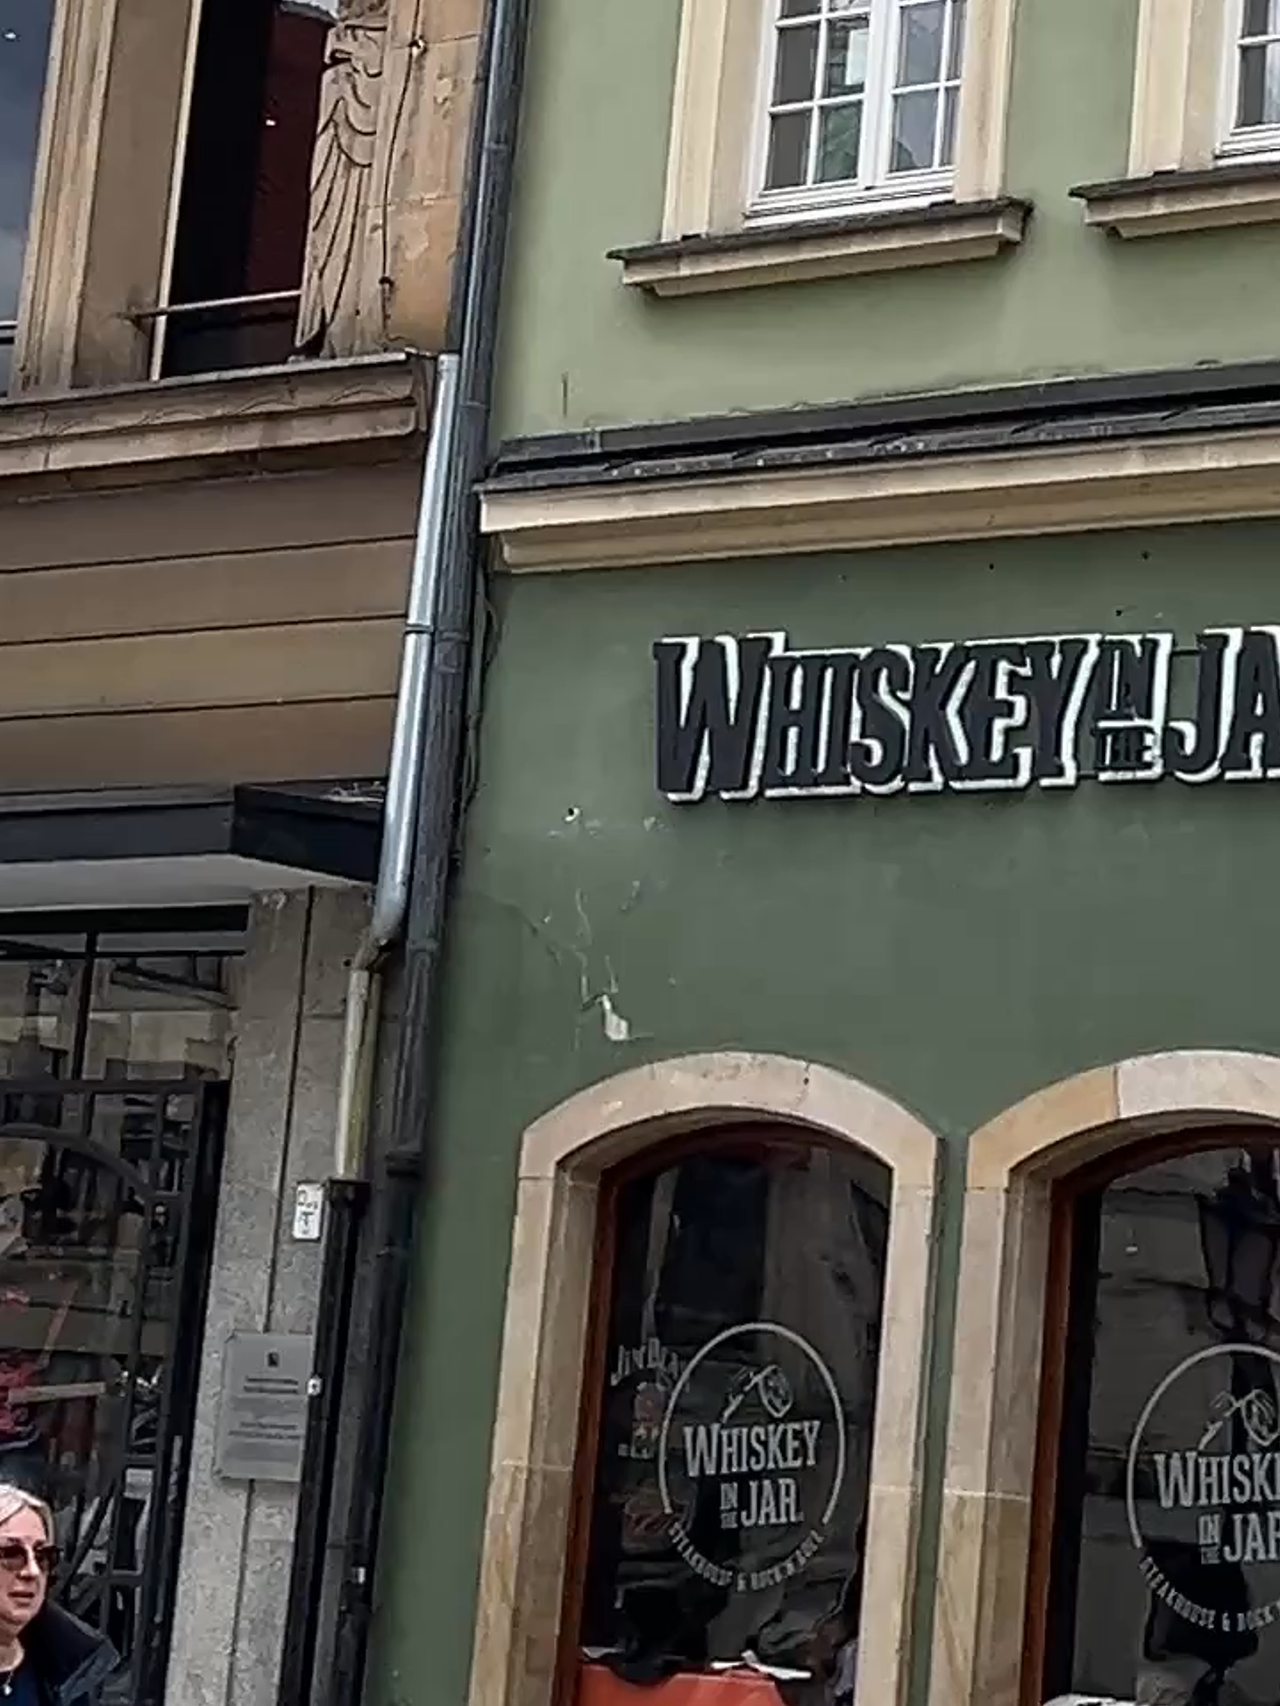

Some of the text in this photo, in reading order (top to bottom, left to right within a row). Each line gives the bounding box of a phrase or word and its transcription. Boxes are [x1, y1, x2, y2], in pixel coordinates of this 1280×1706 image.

[652, 630, 1098, 803] WHISKEY
[683, 1420, 820, 1477] WHISKEY
[741, 1478, 798, 1527] JAR
